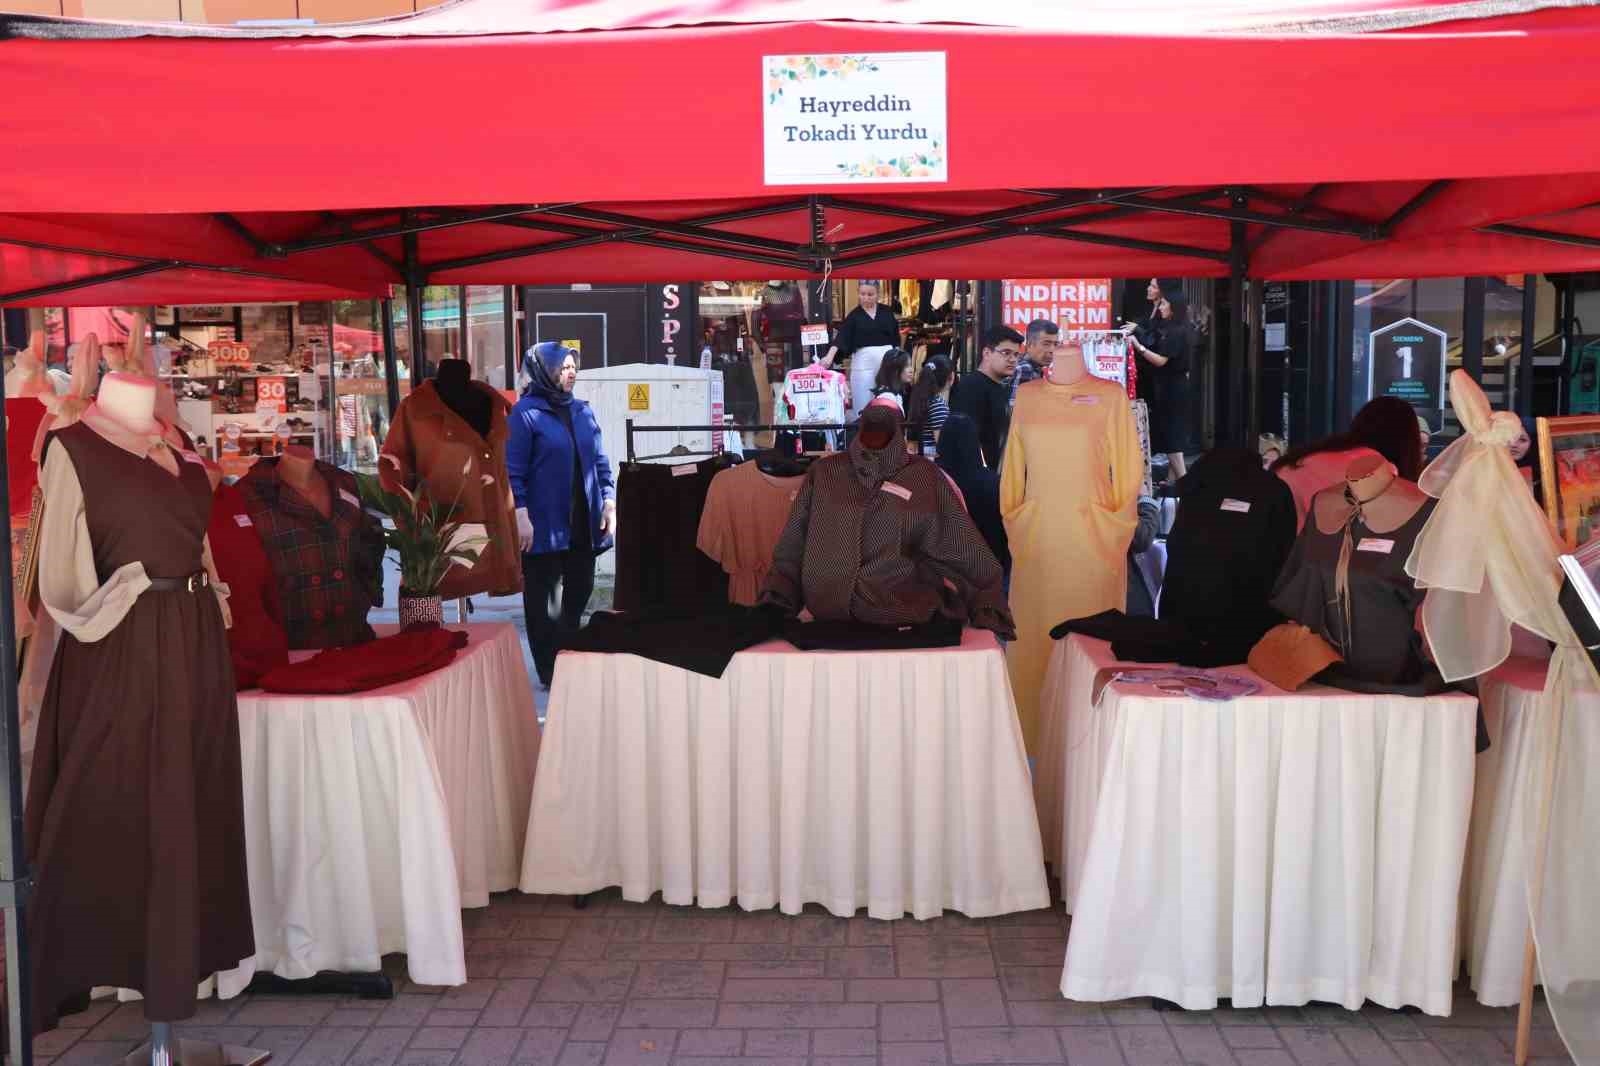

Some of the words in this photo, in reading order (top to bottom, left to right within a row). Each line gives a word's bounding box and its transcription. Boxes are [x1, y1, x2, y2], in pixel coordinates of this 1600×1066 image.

[799, 94, 911, 117] Hayreddin
[783, 123, 857, 142] Tokadi
[861, 122, 927, 141] Yurdu
[1003, 281, 1108, 302] İNDİRİM
[1395, 346, 1413, 379] 1
[258, 382, 286, 398] 30
[797, 379, 815, 389] 300
